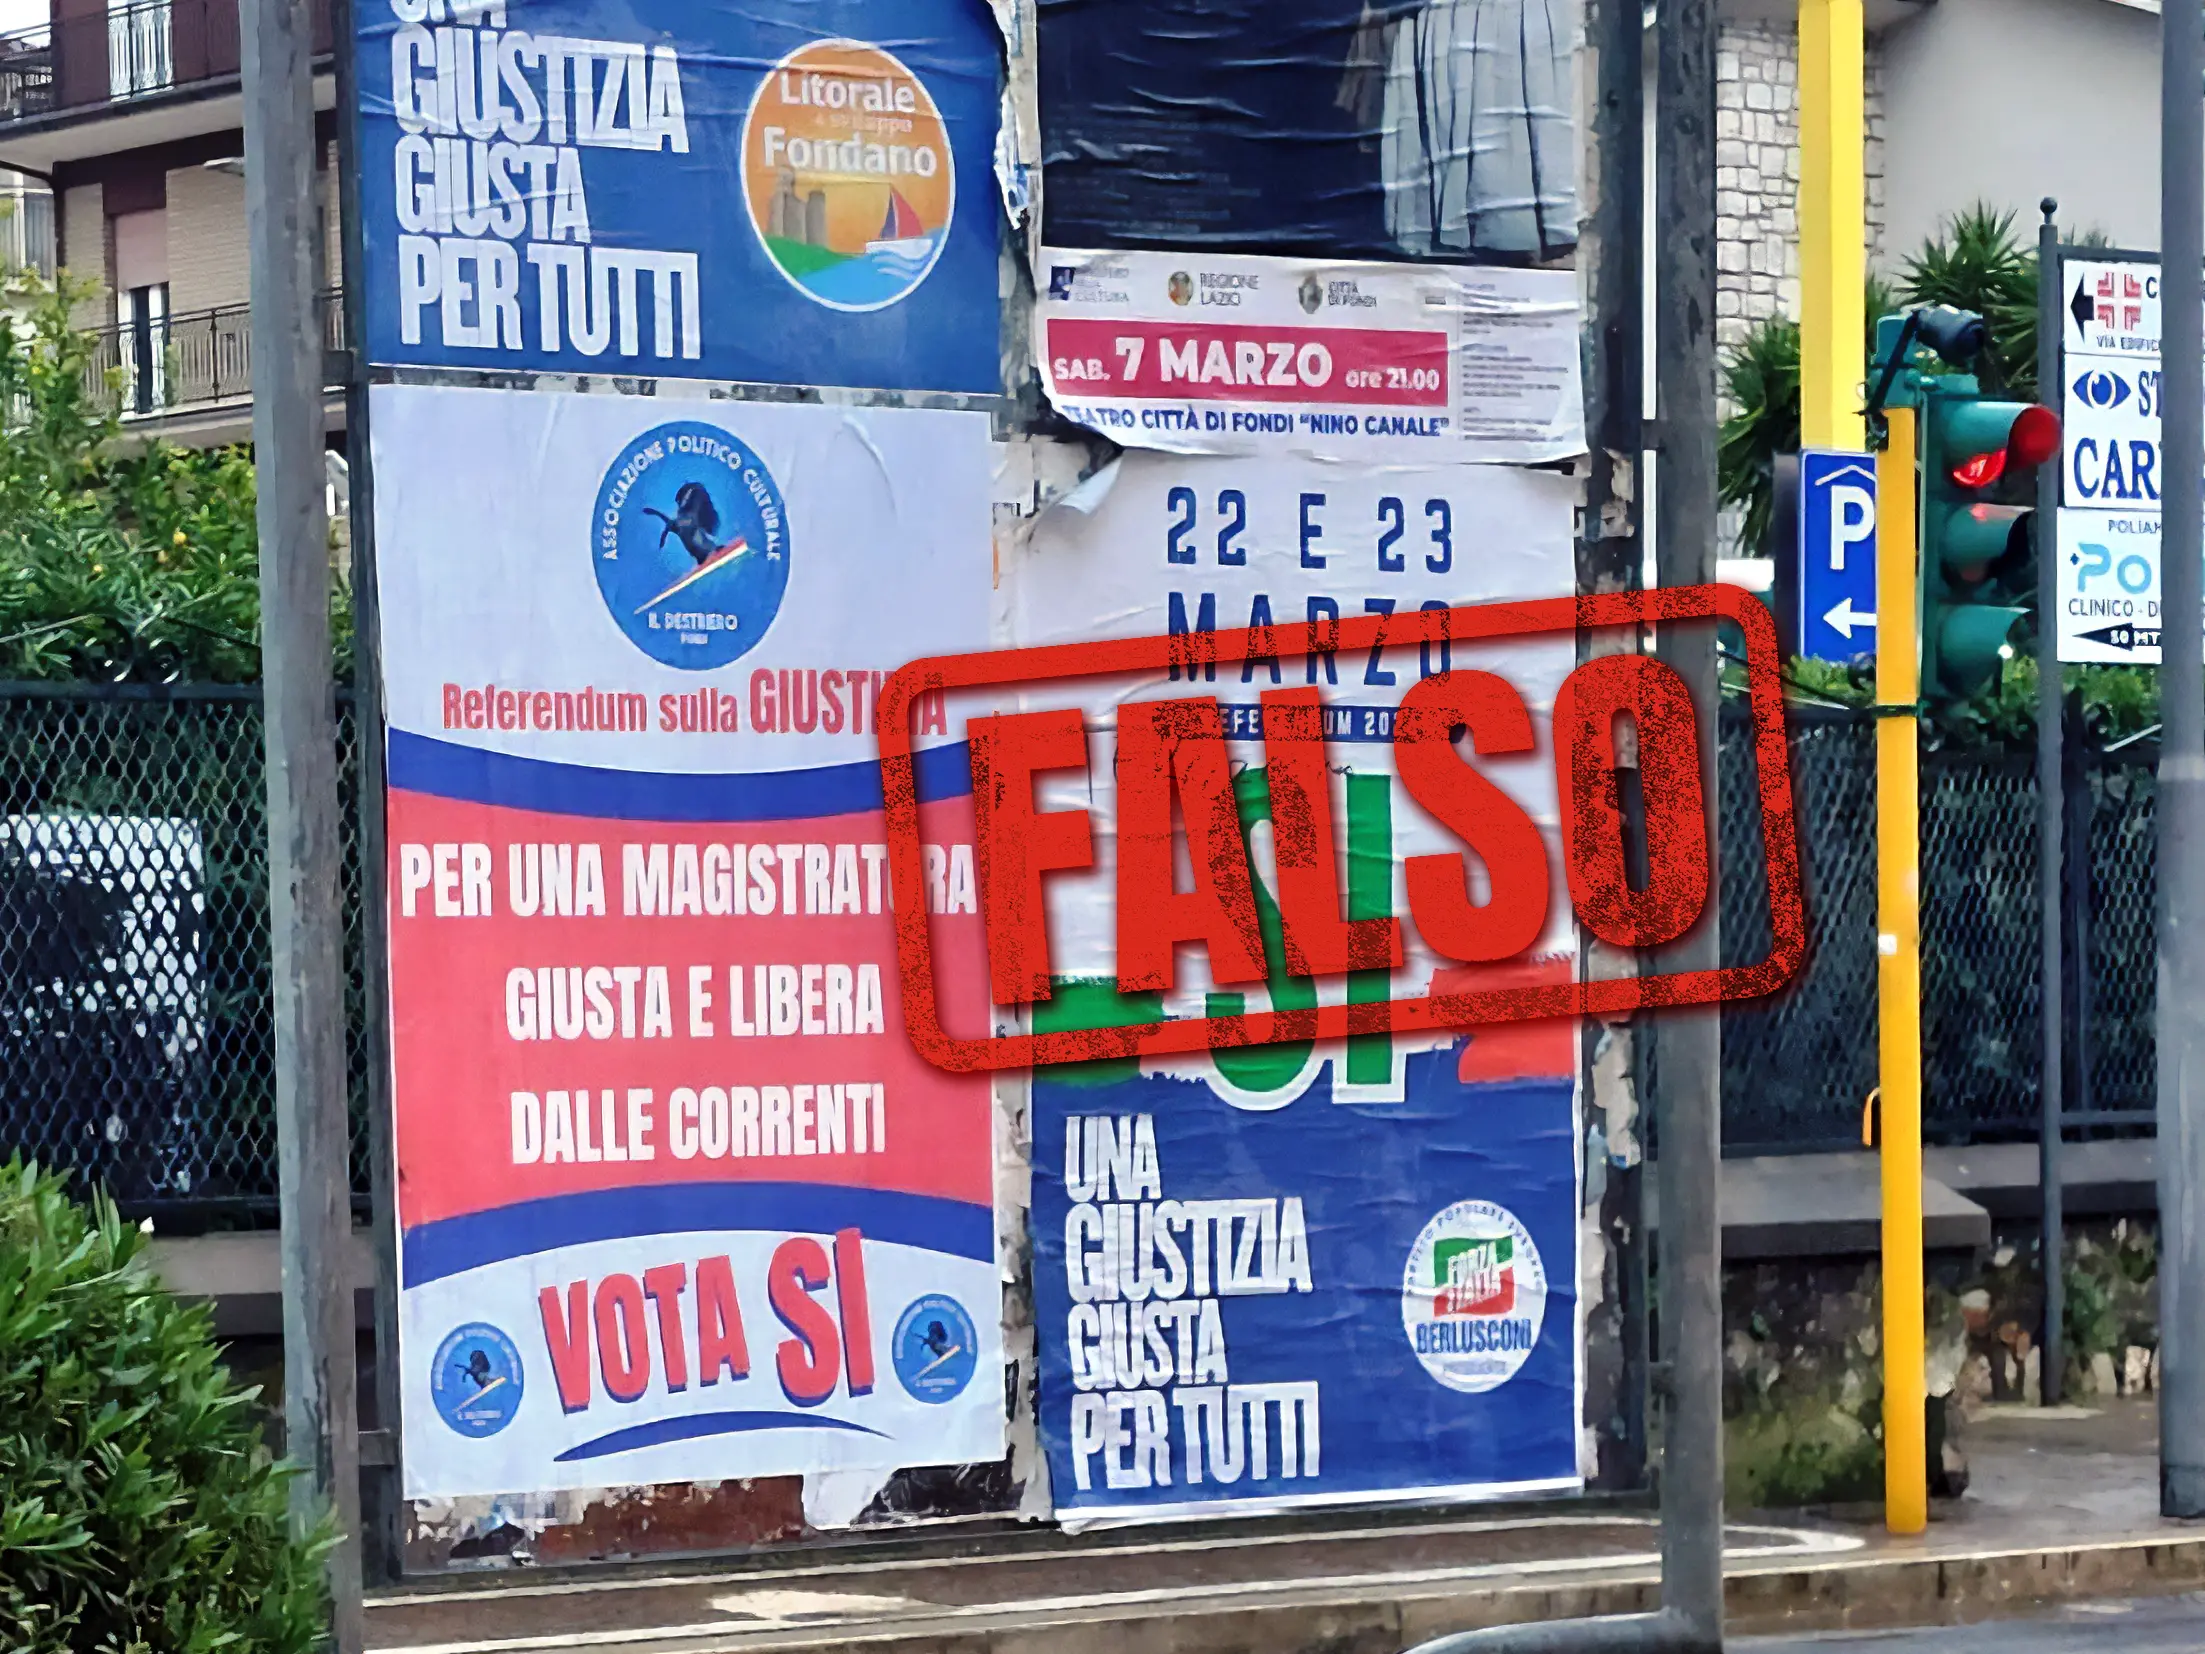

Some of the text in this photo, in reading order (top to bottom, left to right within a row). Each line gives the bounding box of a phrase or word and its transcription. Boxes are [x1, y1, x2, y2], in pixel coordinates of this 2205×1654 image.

[392, 23, 689, 153] GIUSTIZIA
[781, 71, 916, 112] Litorale
[396, 134, 590, 243] GIUSTA
[764, 126, 937, 177] Fondano
[398, 237, 700, 360] PER TUTTI
[1055, 358, 1110, 381] SAB.
[1115, 337, 1144, 381] 7
[1159, 338, 1332, 388] MARZO
[1345, 368, 1383, 388] ore
[1386, 367, 1440, 392] 21.00
[1141, 404, 1199, 430] CITTÀ
[1205, 411, 1226, 431] DI
[1232, 412, 1294, 433] FONDI
[2074, 437, 2161, 500] CAR
[1168, 487, 1452, 573] 22 E 23
[1830, 485, 1875, 570] P
[1168, 591, 1451, 686] MARZO
[2068, 598, 2133, 617] CLINICO
[2148, 600, 2160, 618] D
[443, 668, 947, 736] Referendum sulla GIUSTIIA
[400, 843, 977, 917] PER UNA MAGISTRATRA
[506, 964, 884, 1040] GIUSTA E LIBERA
[511, 1083, 885, 1164] DALLE CORRENTI
[1065, 1113, 1161, 1202] UNA
[1066, 1197, 1312, 1301] GIUSTIZIA
[539, 1228, 875, 1415] VOTA SI
[1068, 1299, 1227, 1390] GIUSTA
[1416, 1319, 1532, 1354] BERLUSCONI
[1071, 1381, 1319, 1490] PER TUTTI
